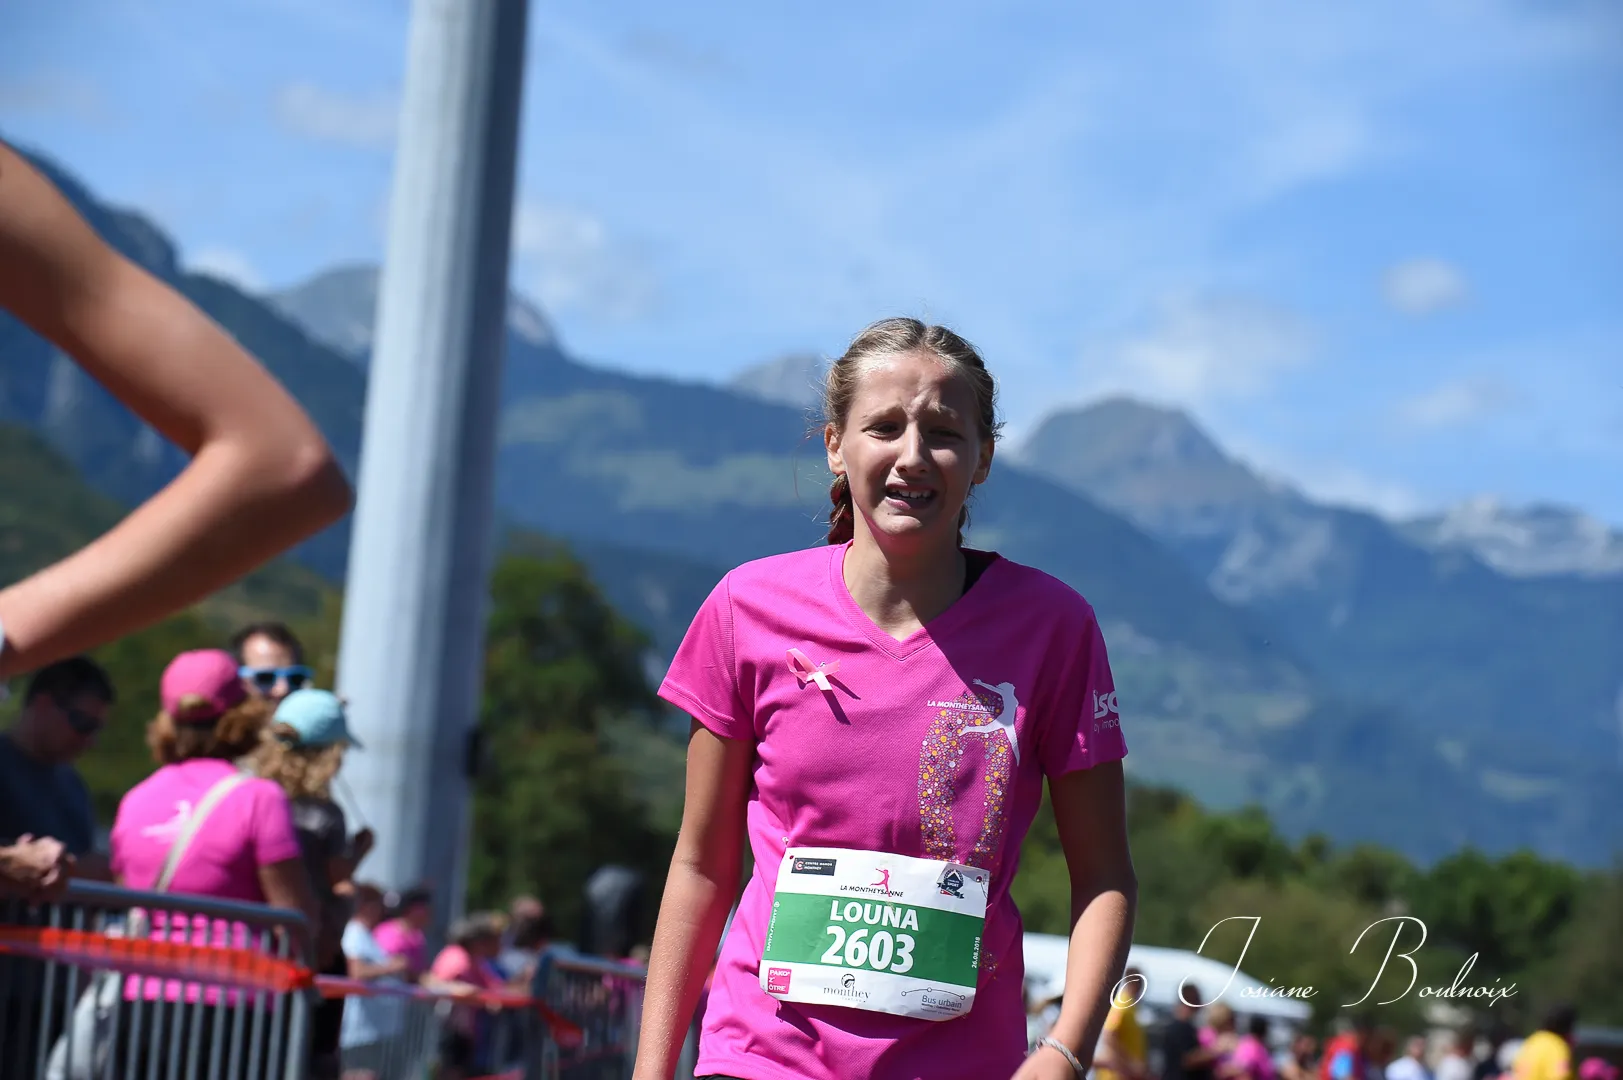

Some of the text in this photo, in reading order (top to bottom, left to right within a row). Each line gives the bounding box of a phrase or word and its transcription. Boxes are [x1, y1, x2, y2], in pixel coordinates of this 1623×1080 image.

[936, 701, 996, 712] MONTHEYSANNE
[848, 886, 904, 898] MONTHEYSANNE
[830, 900, 919, 931] LOUNA
[820, 925, 915, 974] 2603
[921, 995, 937, 1004] Bus
[938, 998, 962, 1009] urbain
